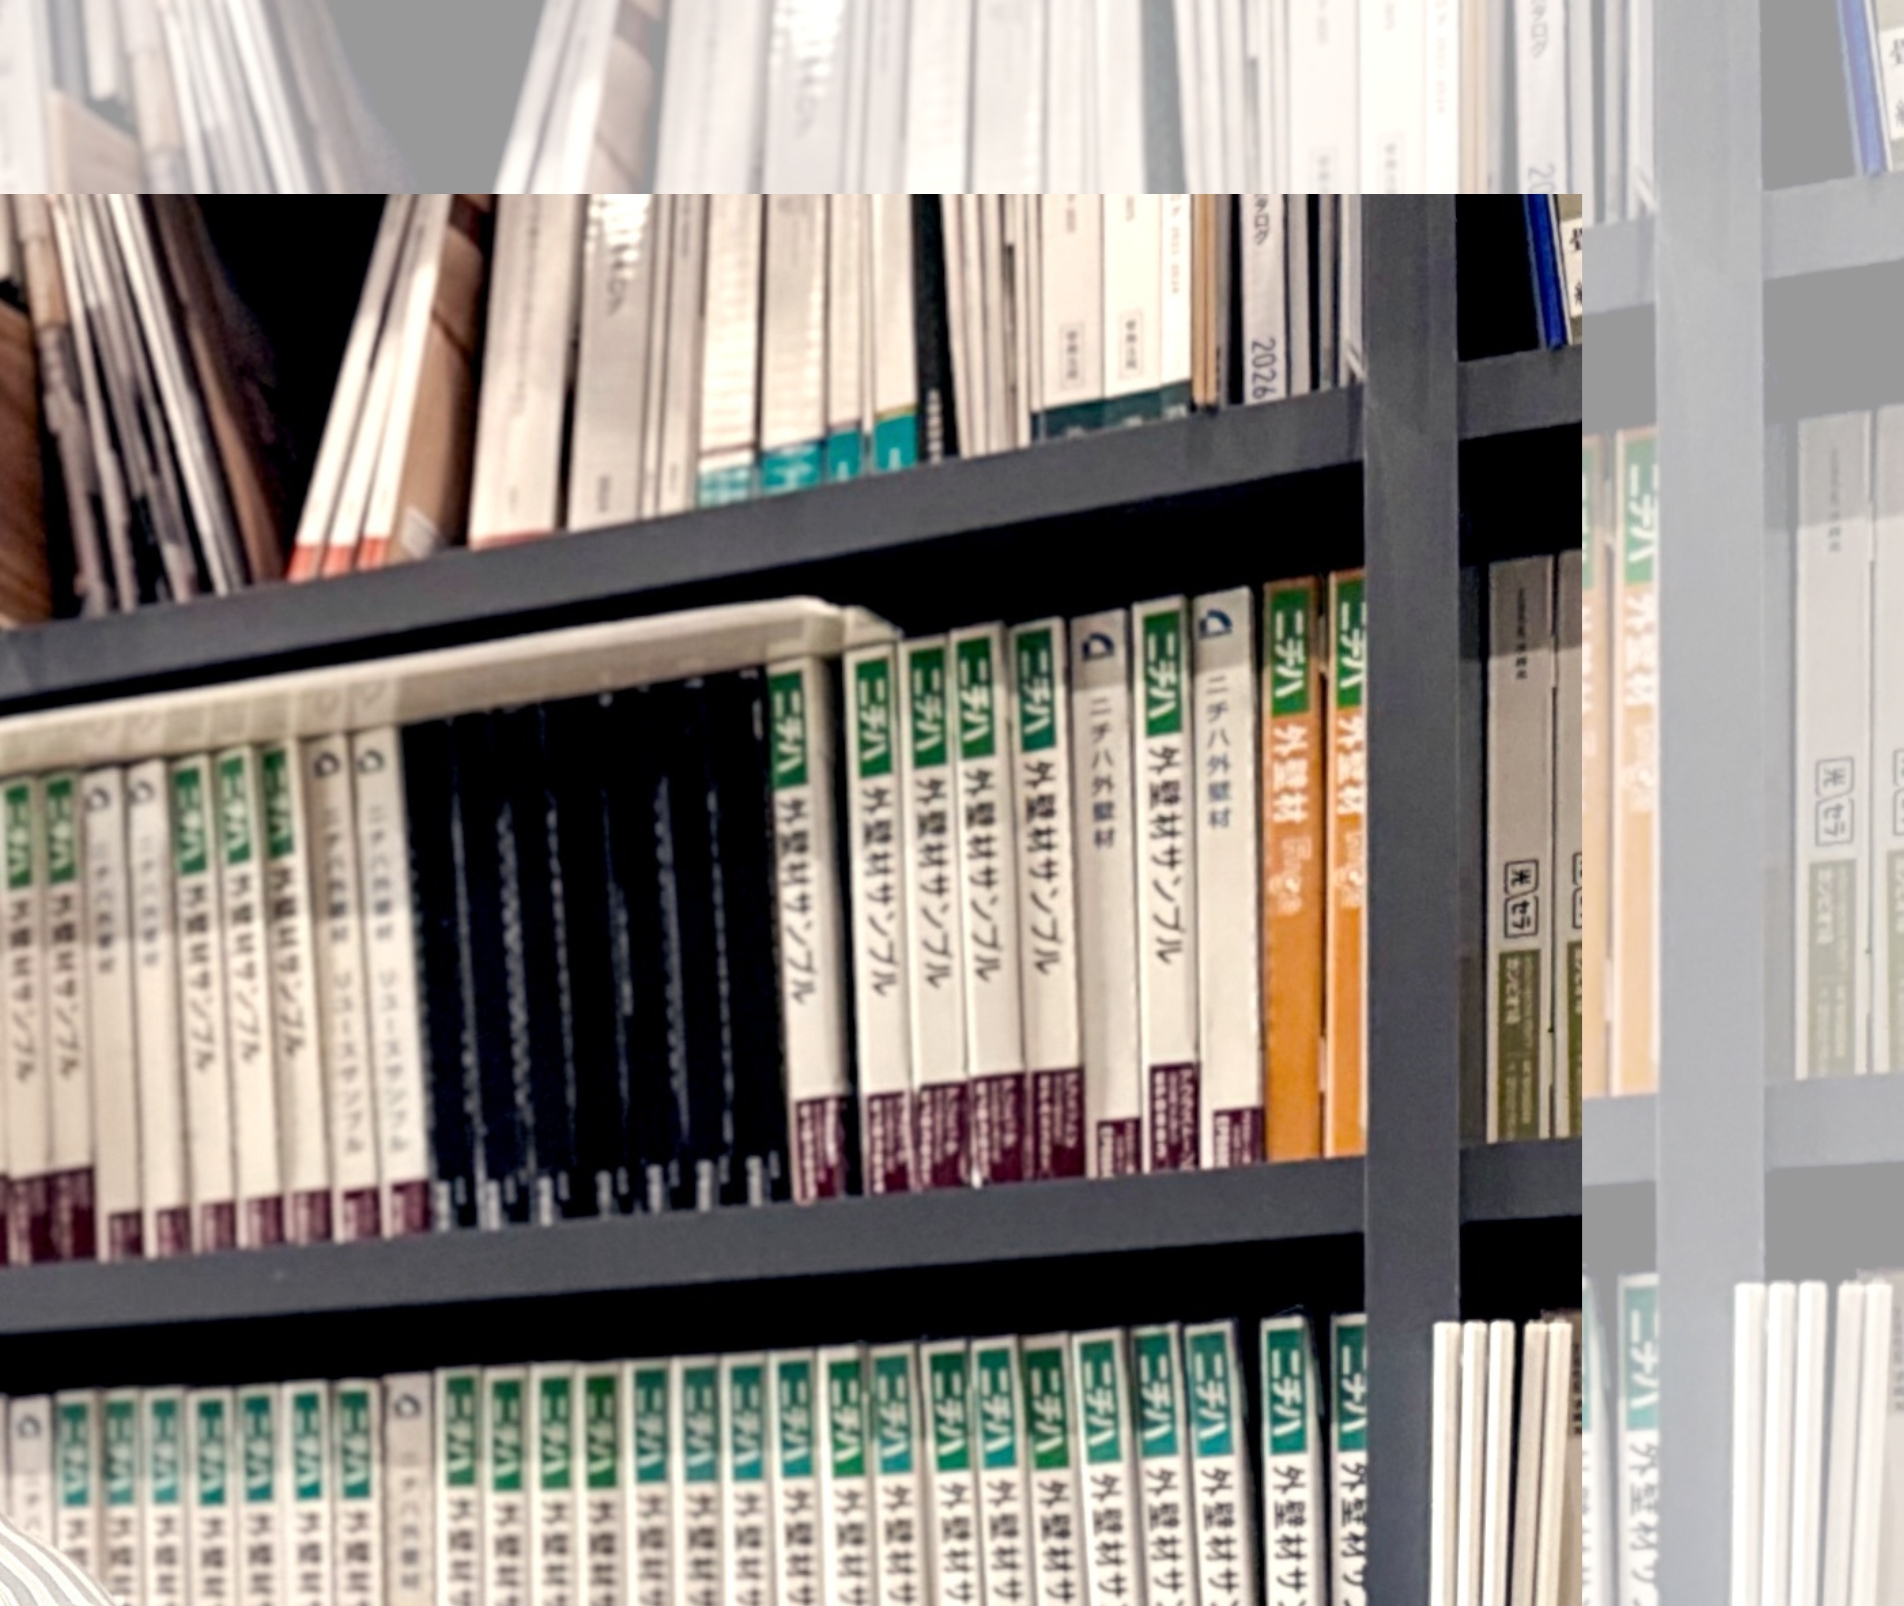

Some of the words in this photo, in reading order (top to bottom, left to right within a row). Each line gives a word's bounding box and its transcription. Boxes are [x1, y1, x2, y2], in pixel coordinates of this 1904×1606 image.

[1251, 337, 1277, 400] 2026
[1022, 650, 1050, 734] ニチハ
[1147, 633, 1176, 719] ニチハ
[1274, 610, 1305, 698] ニチハ
[859, 679, 886, 763] ニチハ
[913, 668, 942, 751] ニチハ
[960, 658, 990, 741] ニチハ
[862, 787, 900, 996] 外壁材サンプル
[916, 777, 953, 989] 外壁材サンプル
[964, 767, 1002, 982] 外壁材サンプル
[1024, 761, 1063, 976] 外壁材サンプル
[1147, 745, 1191, 965] 外壁材サンプル
[1032, 1368, 1063, 1453] ニチハ
[1083, 1360, 1115, 1446] ニチハ
[1140, 1354, 1172, 1440] ニチハ
[1195, 1353, 1227, 1439] ニチハ
[1272, 1349, 1302, 1436] ニチハ
